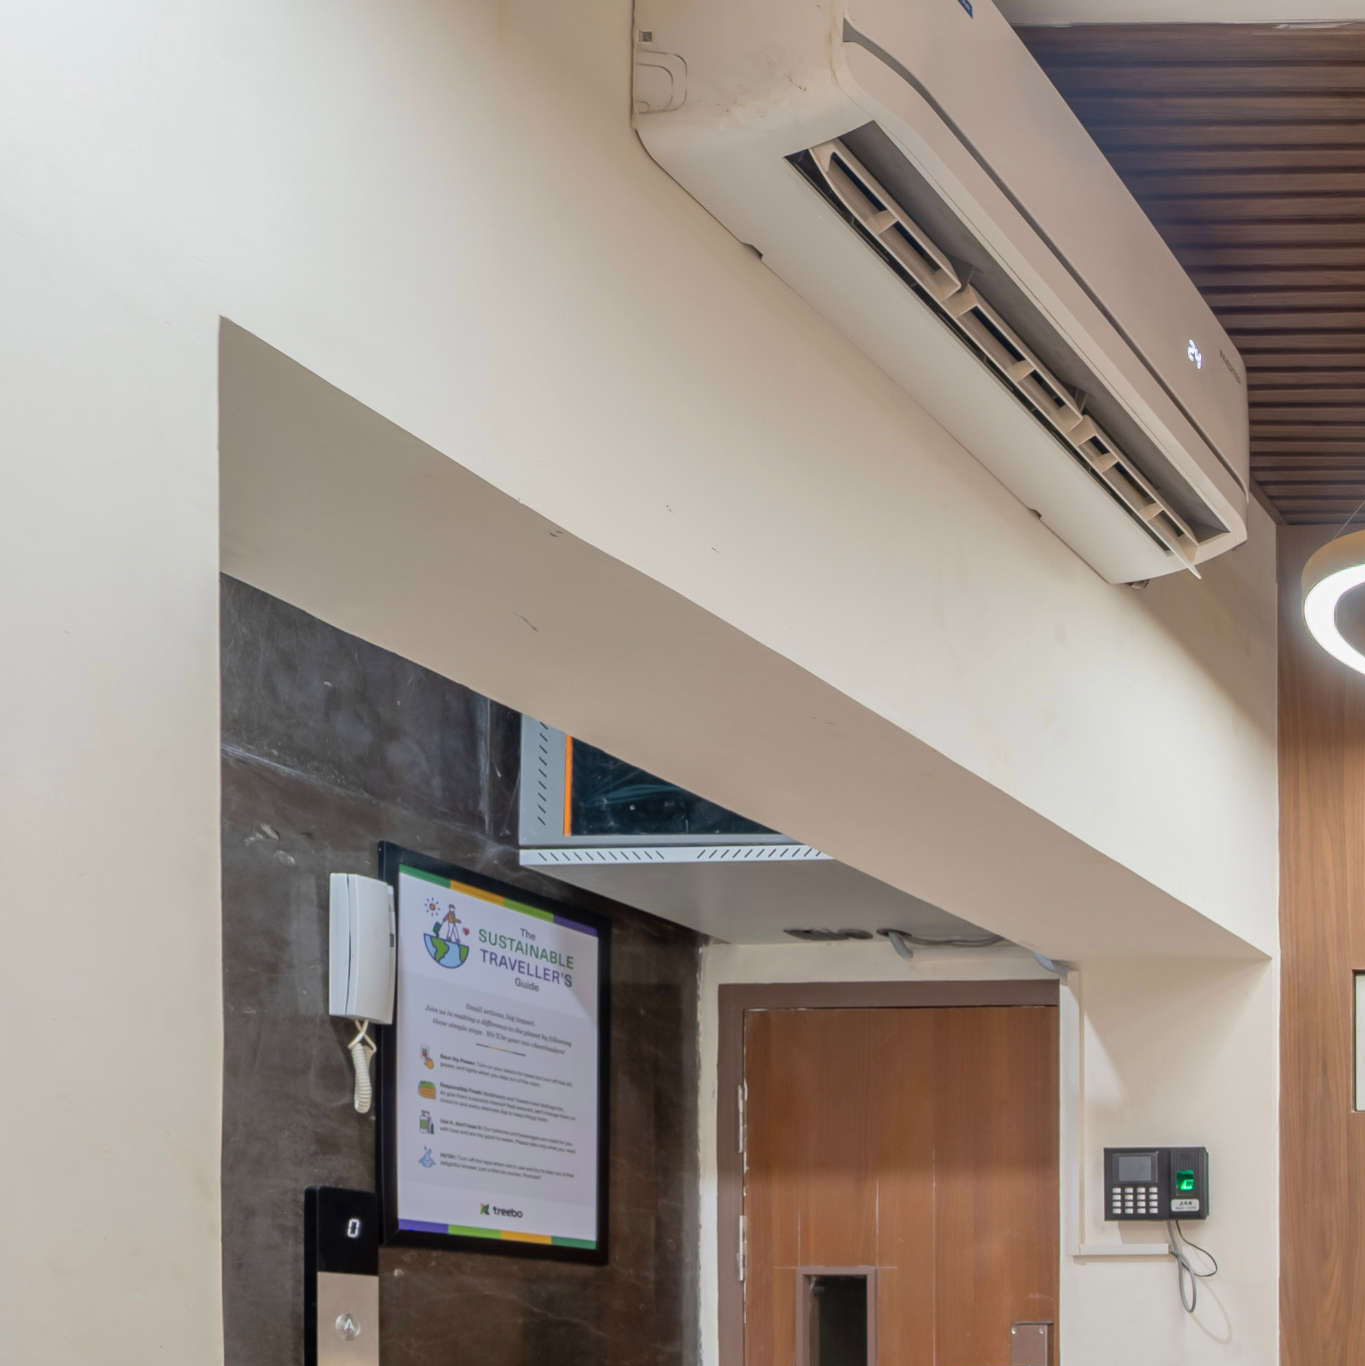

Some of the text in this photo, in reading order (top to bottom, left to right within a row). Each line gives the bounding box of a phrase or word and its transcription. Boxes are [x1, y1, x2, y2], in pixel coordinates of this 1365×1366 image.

[520, 928, 536, 941] The
[478, 928, 574, 970] SUSTAINABLE
[479, 948, 573, 988] TRAVELLER'S
[514, 977, 540, 992] Guide
[492, 1205, 524, 1219] treebo
